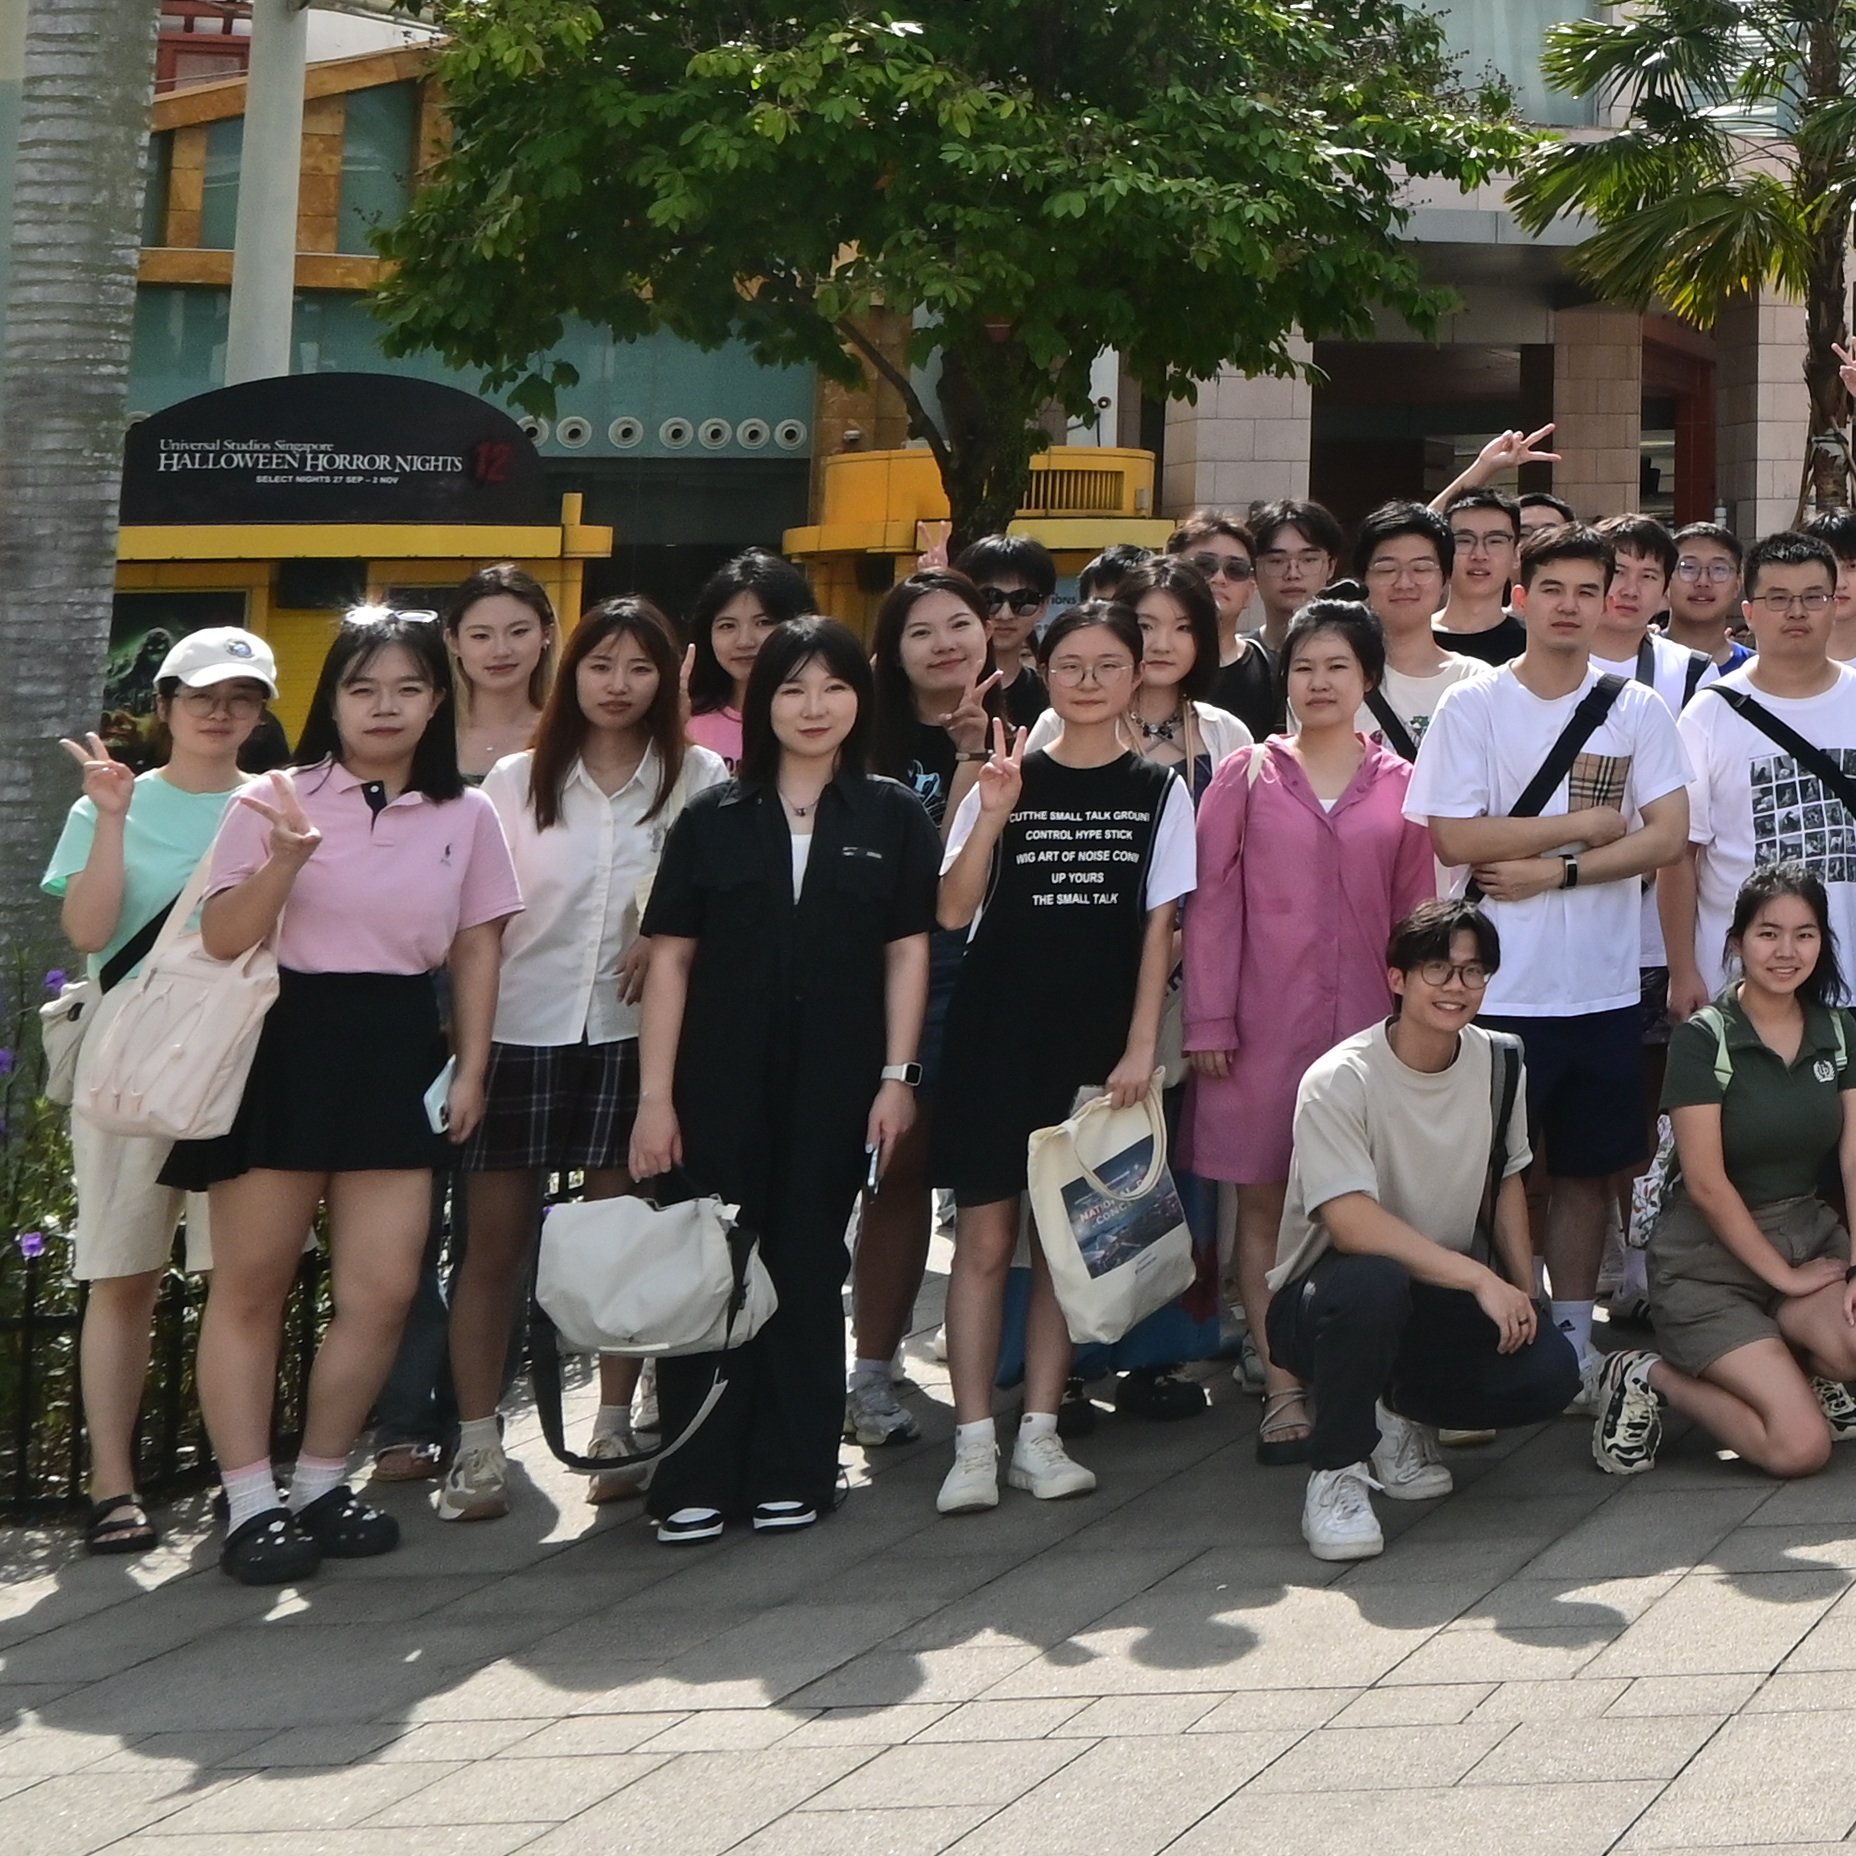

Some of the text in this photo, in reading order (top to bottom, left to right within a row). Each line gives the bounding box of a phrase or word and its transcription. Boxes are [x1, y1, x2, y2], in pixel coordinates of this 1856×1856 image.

[160, 439, 335, 454] Universal Studios Singapore
[157, 441, 513, 482] HALLOWEEN HORROR NIGHTS 12
[256, 475, 293, 484] SELECT
[295, 475, 331, 484] NIGHTS
[332, 476, 343, 484] 27
[345, 476, 364, 484] SEP
[380, 476, 399, 484] NOV
[1050, 811, 1083, 822] SMALL
[1085, 810, 1112, 822] TALK
[1025, 829, 1133, 841] CONTROL HYPE STICK
[1037, 850, 1060, 863] ART
[1061, 850, 1076, 862] OF
[1077, 850, 1110, 862] NOISE
[1051, 872, 1105, 884] UP YOURS
[1032, 892, 1119, 906] THE SMALL TALK
